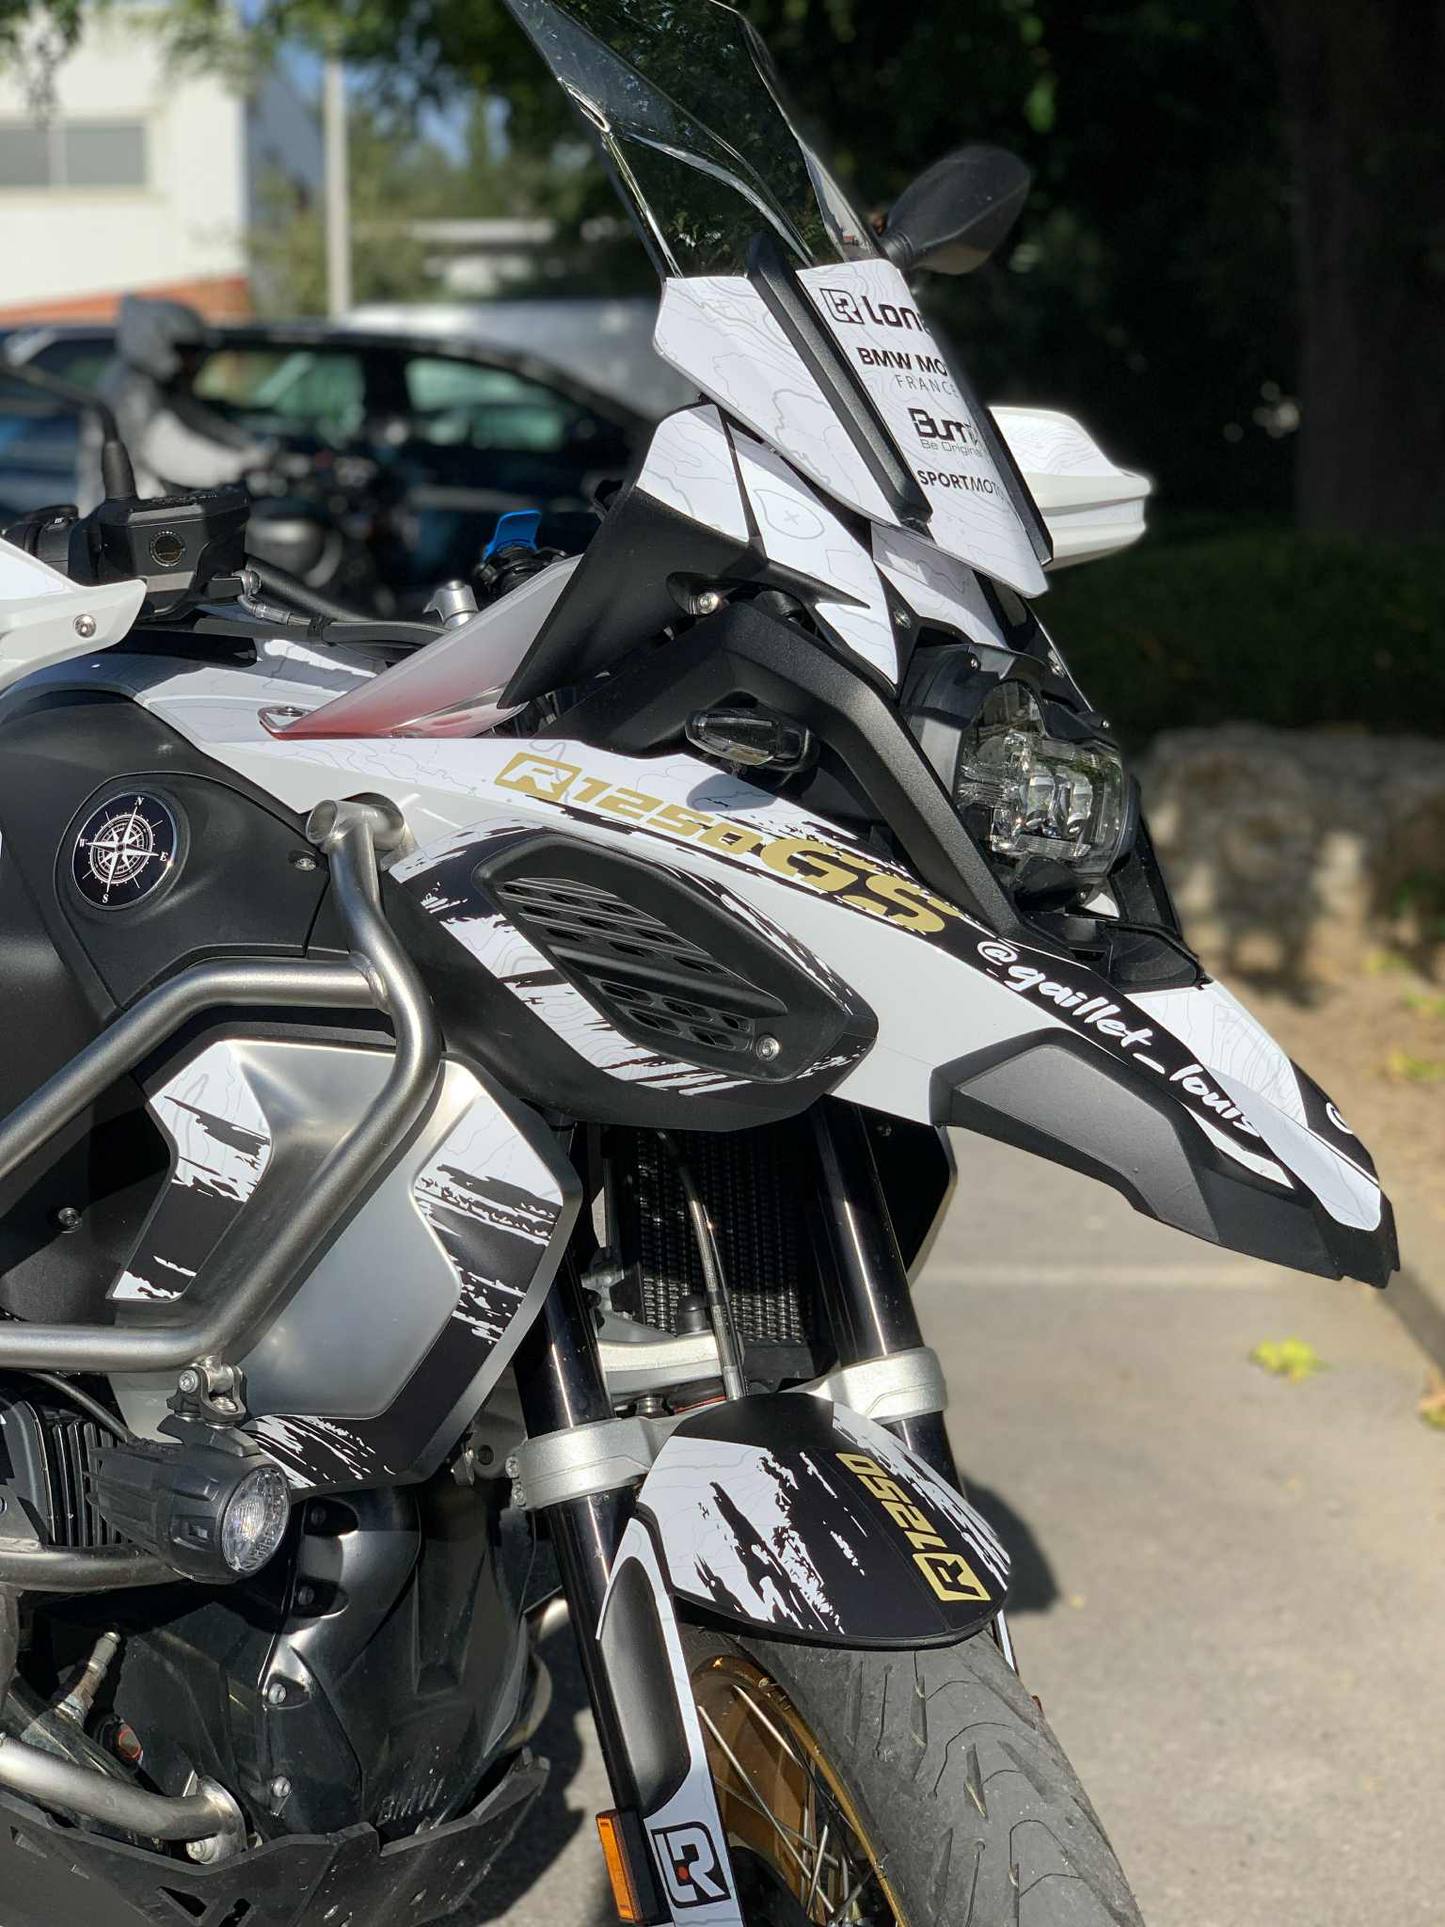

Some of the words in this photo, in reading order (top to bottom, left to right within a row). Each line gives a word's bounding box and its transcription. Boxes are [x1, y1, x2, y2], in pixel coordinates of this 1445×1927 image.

[857, 347, 912, 371] BMW
[920, 439, 938, 450] Be
[159, 852, 168, 861] E
[102, 893, 109, 903] S
